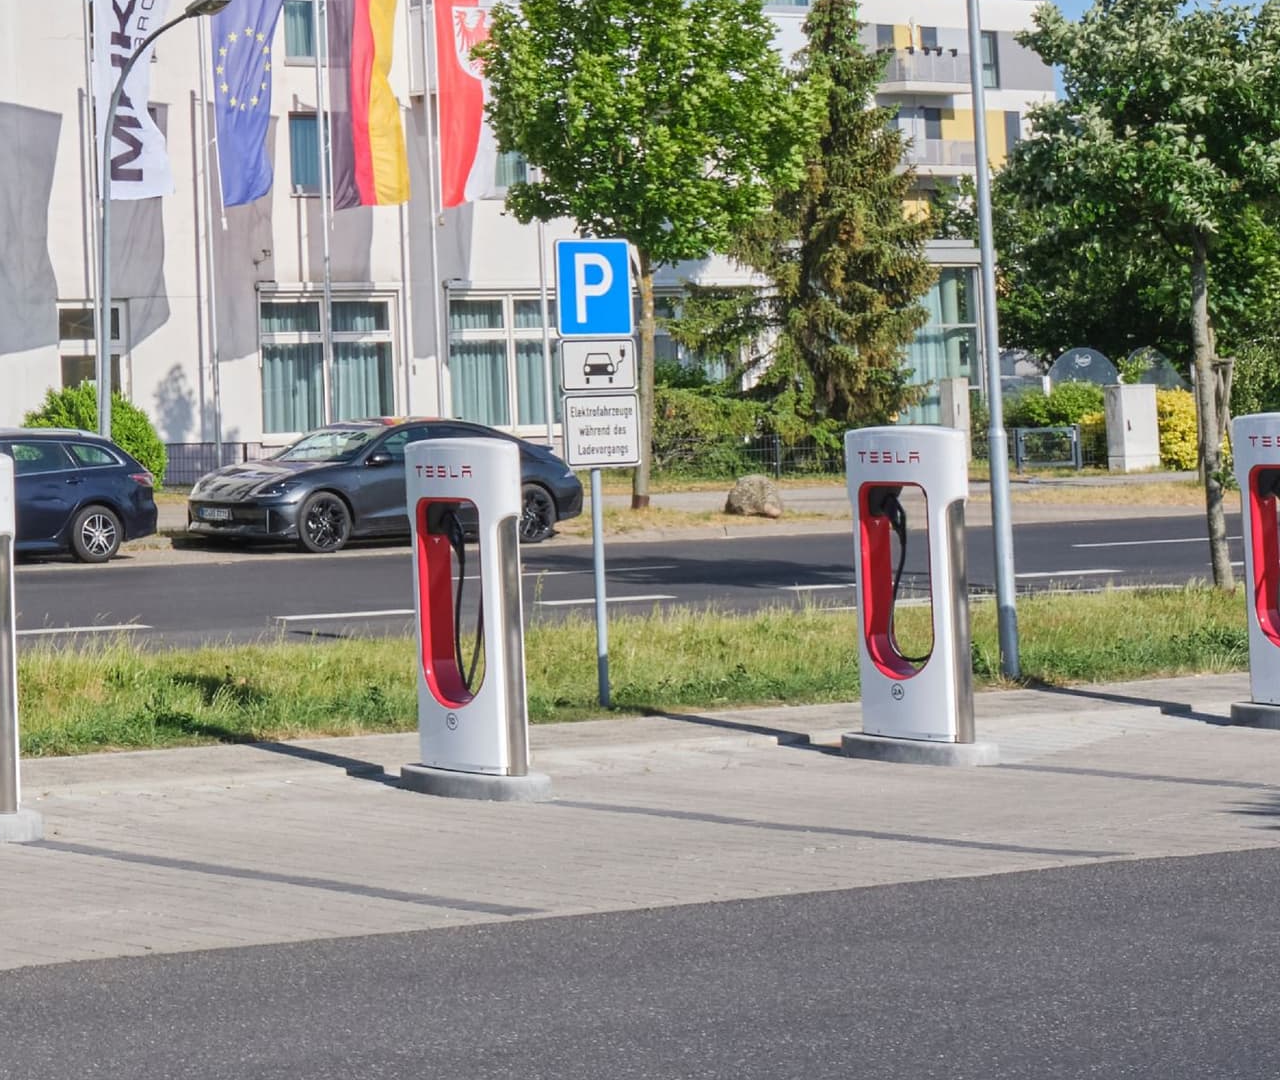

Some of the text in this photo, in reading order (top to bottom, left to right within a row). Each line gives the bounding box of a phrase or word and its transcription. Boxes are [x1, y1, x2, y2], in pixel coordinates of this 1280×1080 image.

[574, 252, 613, 324] P
[570, 405, 634, 419] Elektrofahrzeuge
[579, 424, 628, 437] während des
[577, 443, 630, 458] Ladevorgangs
[857, 451, 920, 464] TESLA
[415, 465, 472, 479] TESLA
